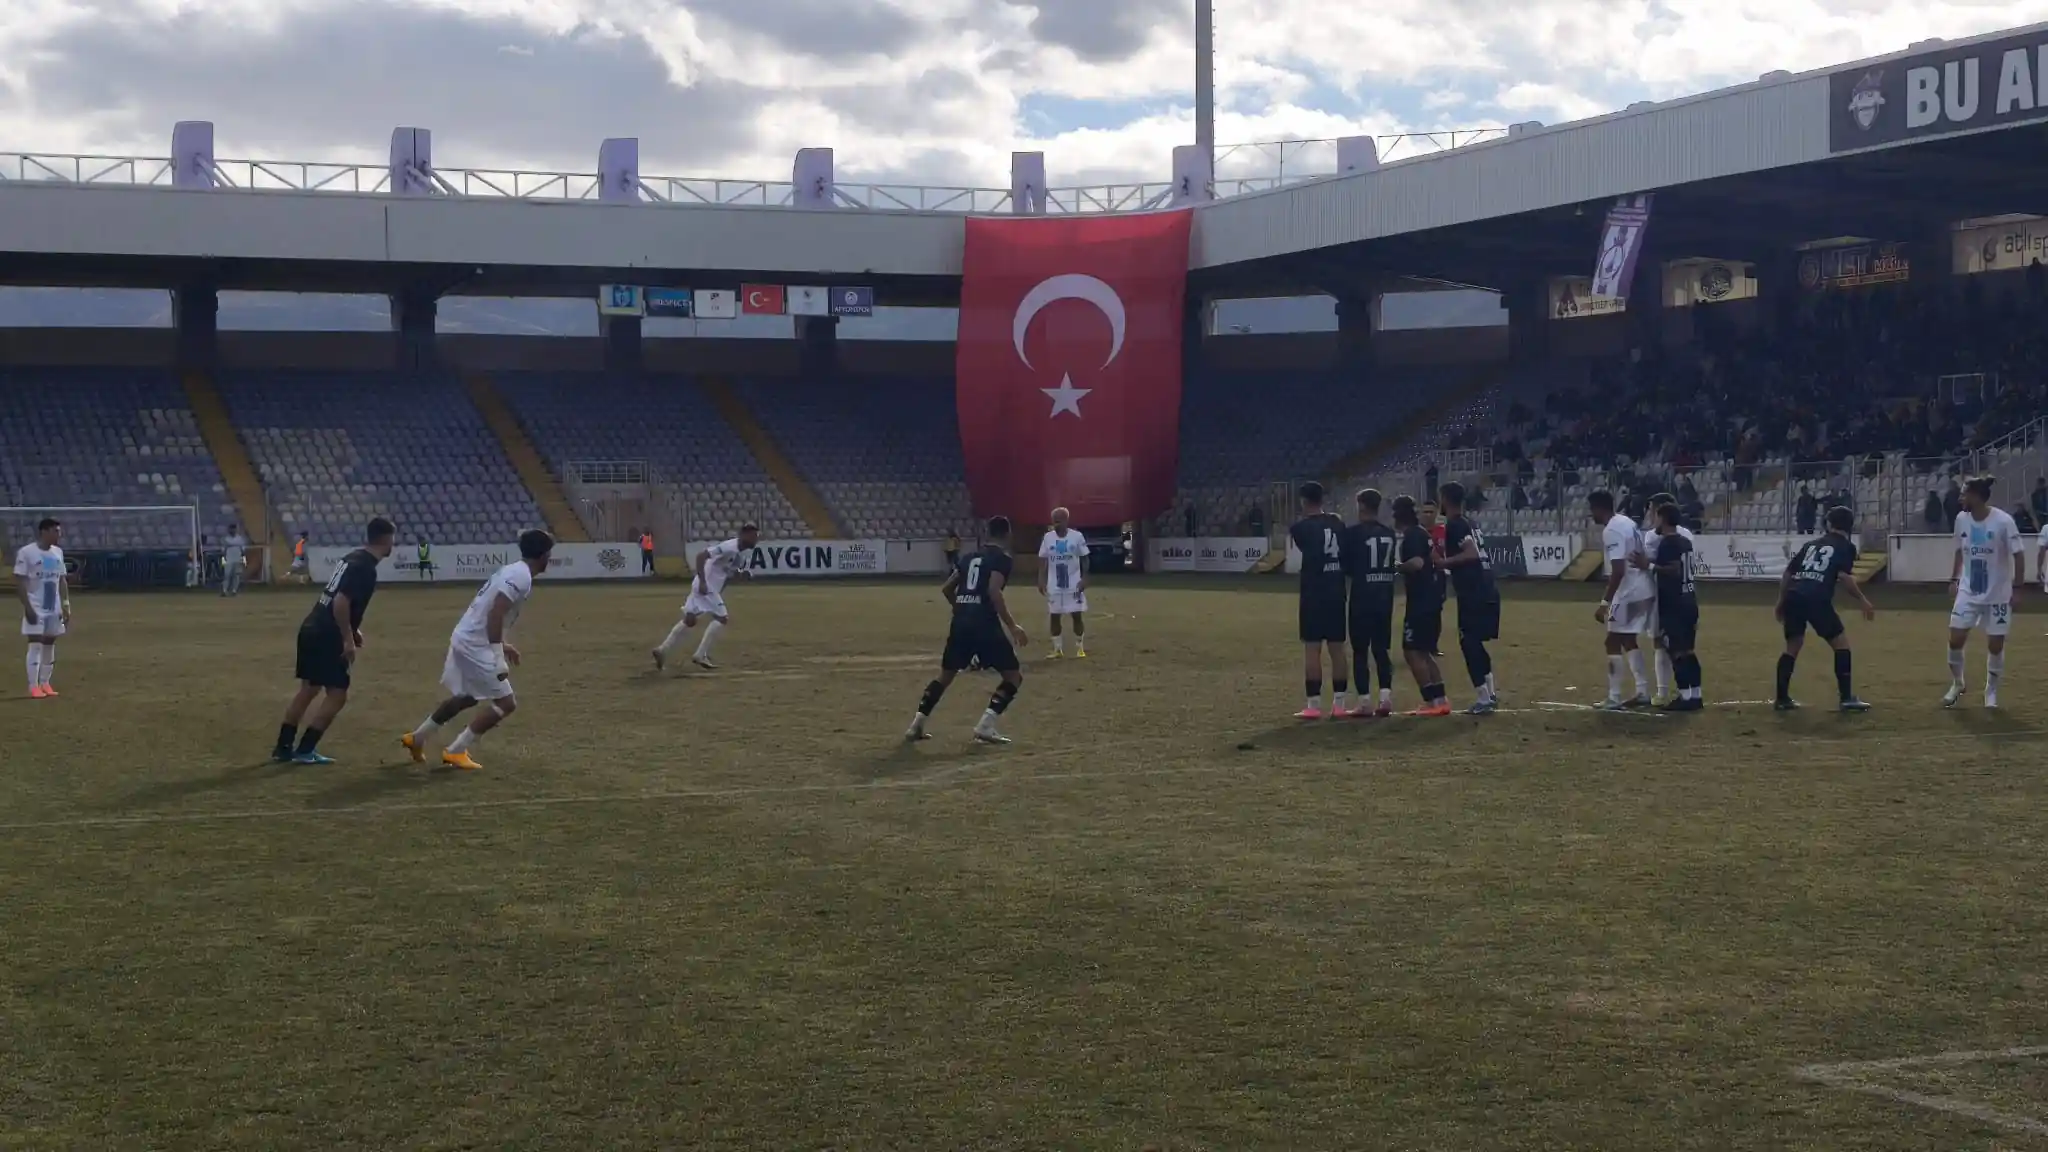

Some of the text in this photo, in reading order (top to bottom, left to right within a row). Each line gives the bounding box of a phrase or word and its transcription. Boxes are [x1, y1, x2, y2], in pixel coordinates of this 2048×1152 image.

[1906, 57, 1980, 129] BU
[742, 545, 832, 569] AYGIN
[1323, 528, 1340, 558] 4
[1365, 537, 1393, 569] 17
[1801, 545, 1835, 572] 43
[966, 557, 983, 590] 6
